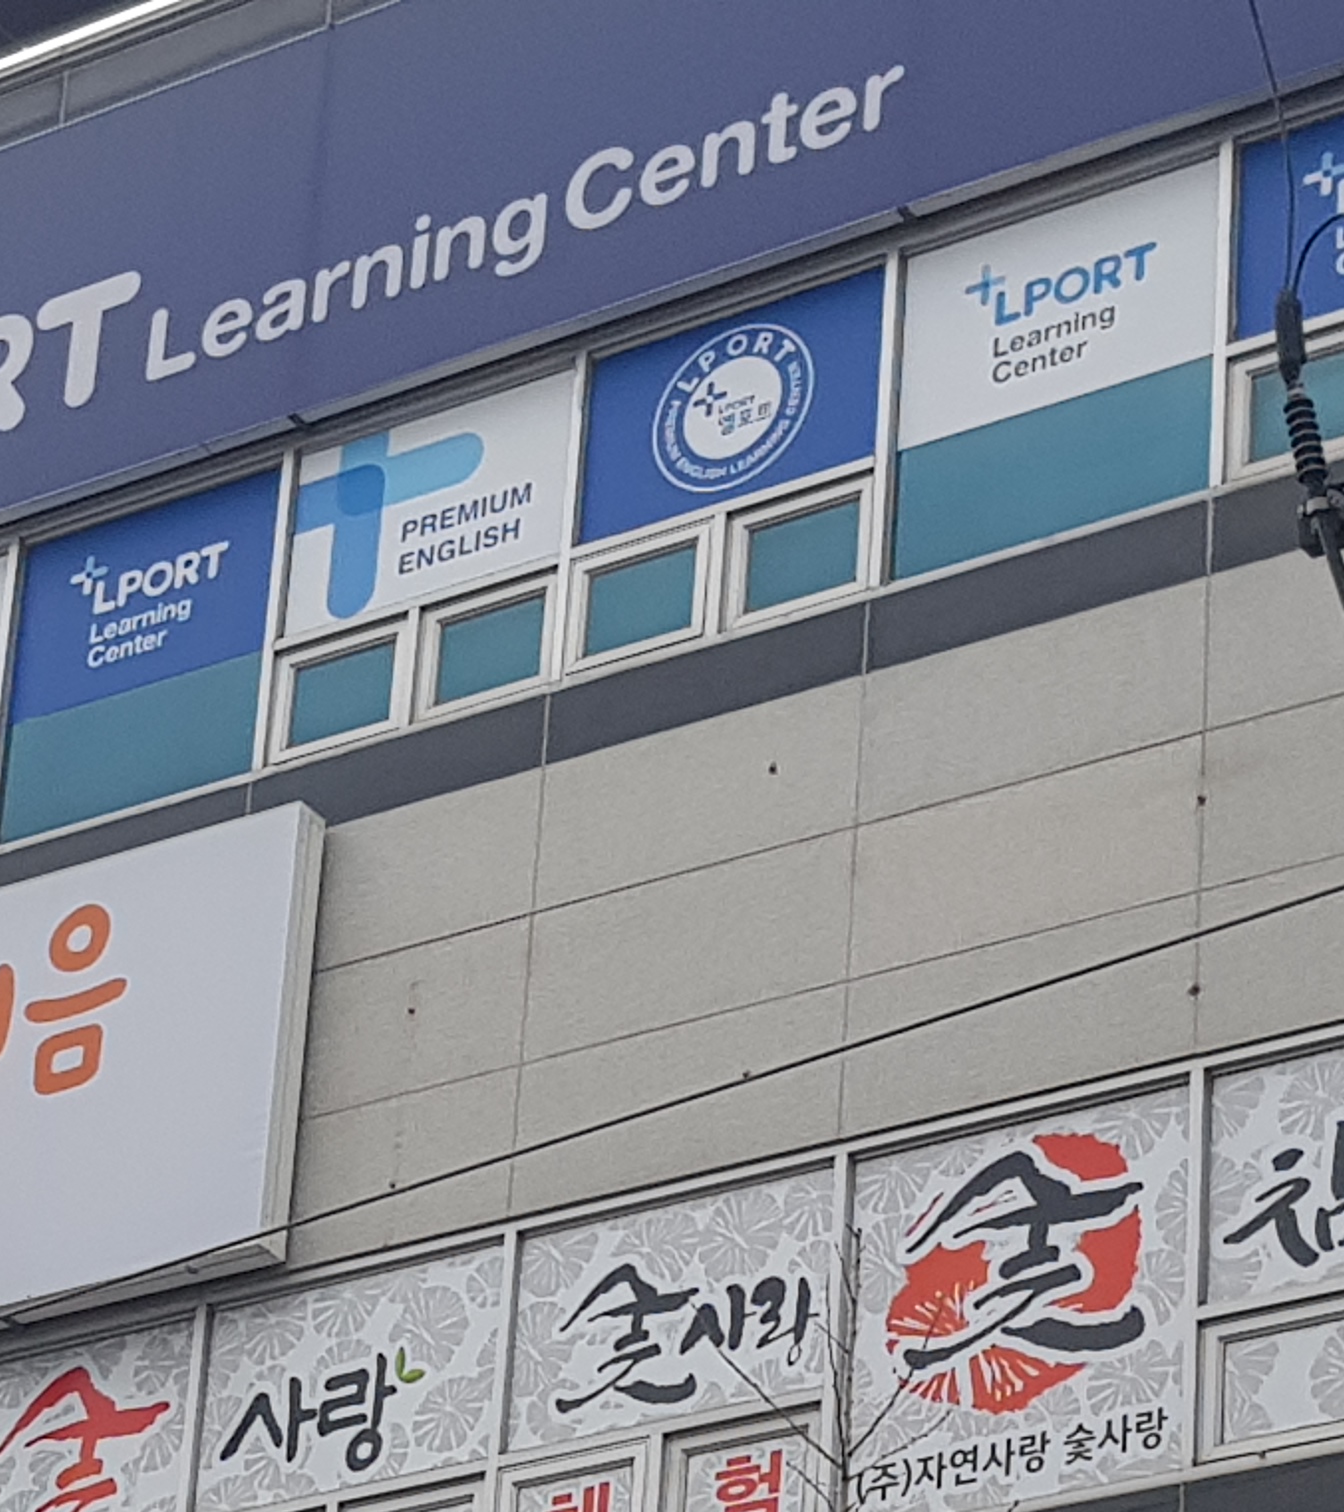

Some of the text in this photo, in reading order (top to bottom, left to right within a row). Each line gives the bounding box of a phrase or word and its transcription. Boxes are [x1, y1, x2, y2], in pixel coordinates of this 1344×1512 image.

[145, 191, 549, 384] Learning
[564, 65, 905, 231] Center
[993, 241, 1158, 325] LPORT
[991, 338, 1088, 385] Center
[992, 303, 1117, 359] Learning
[676, 331, 797, 393] LPORT
[399, 482, 533, 543] PREMIUM
[90, 540, 231, 615] LPORT
[397, 517, 522, 577] ENGLISH
[86, 629, 169, 669] Center
[88, 598, 193, 646] Learning
[856, 1407, 1168, 1504] (주)자연사랑 숯사랑
